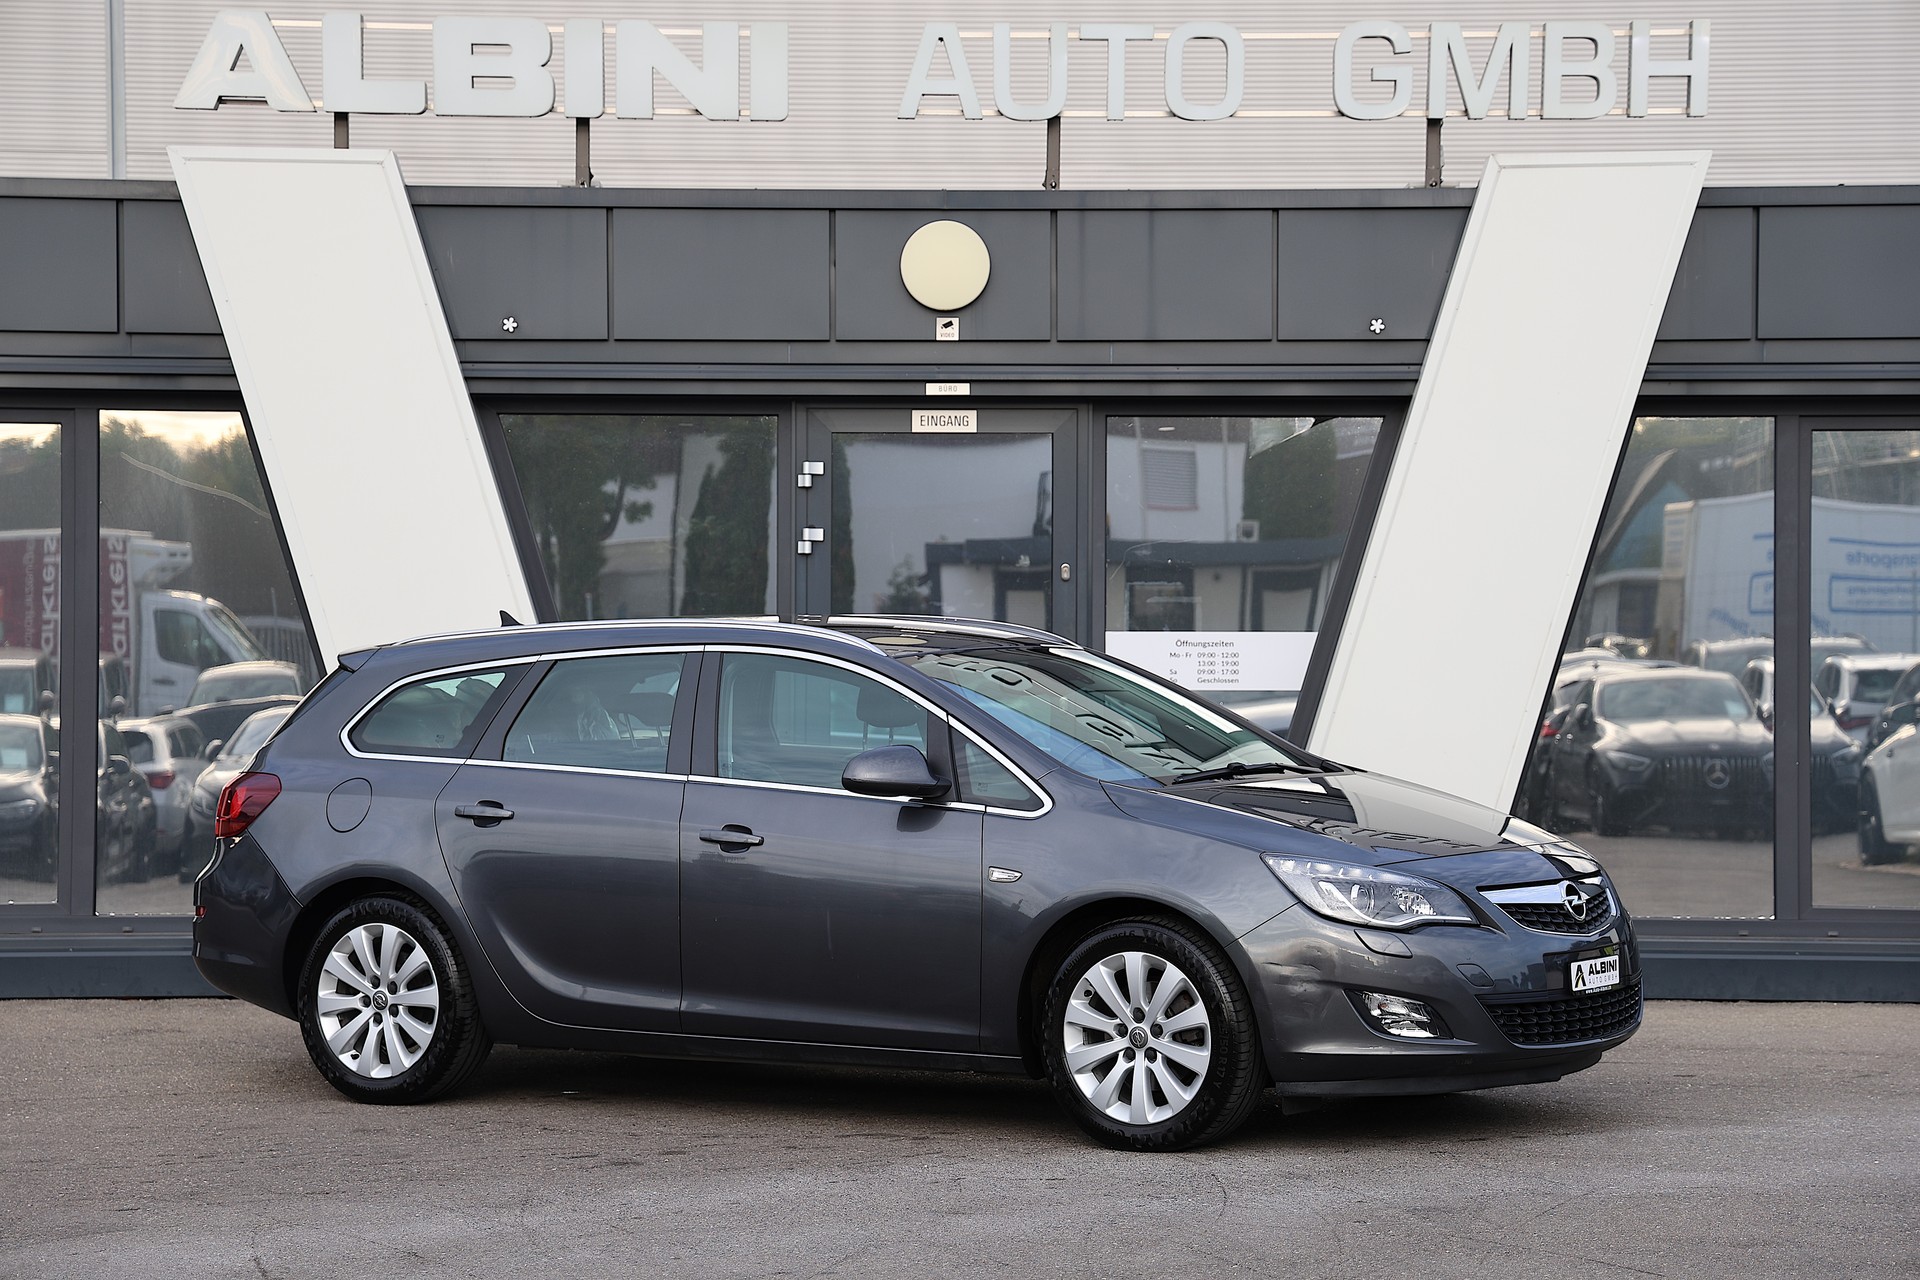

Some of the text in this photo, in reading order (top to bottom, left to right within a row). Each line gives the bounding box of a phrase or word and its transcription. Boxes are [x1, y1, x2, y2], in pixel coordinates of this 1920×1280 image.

[173, 10, 1711, 122] ALBINI AUTO GMBH
[938, 384, 958, 392] BÜRO
[920, 415, 969, 427] EINGANG
[1175, 639, 1234, 648] Öffnungszeiten
[1588, 959, 1617, 977] ALBINI
[1588, 976, 1603, 984] AUTO
